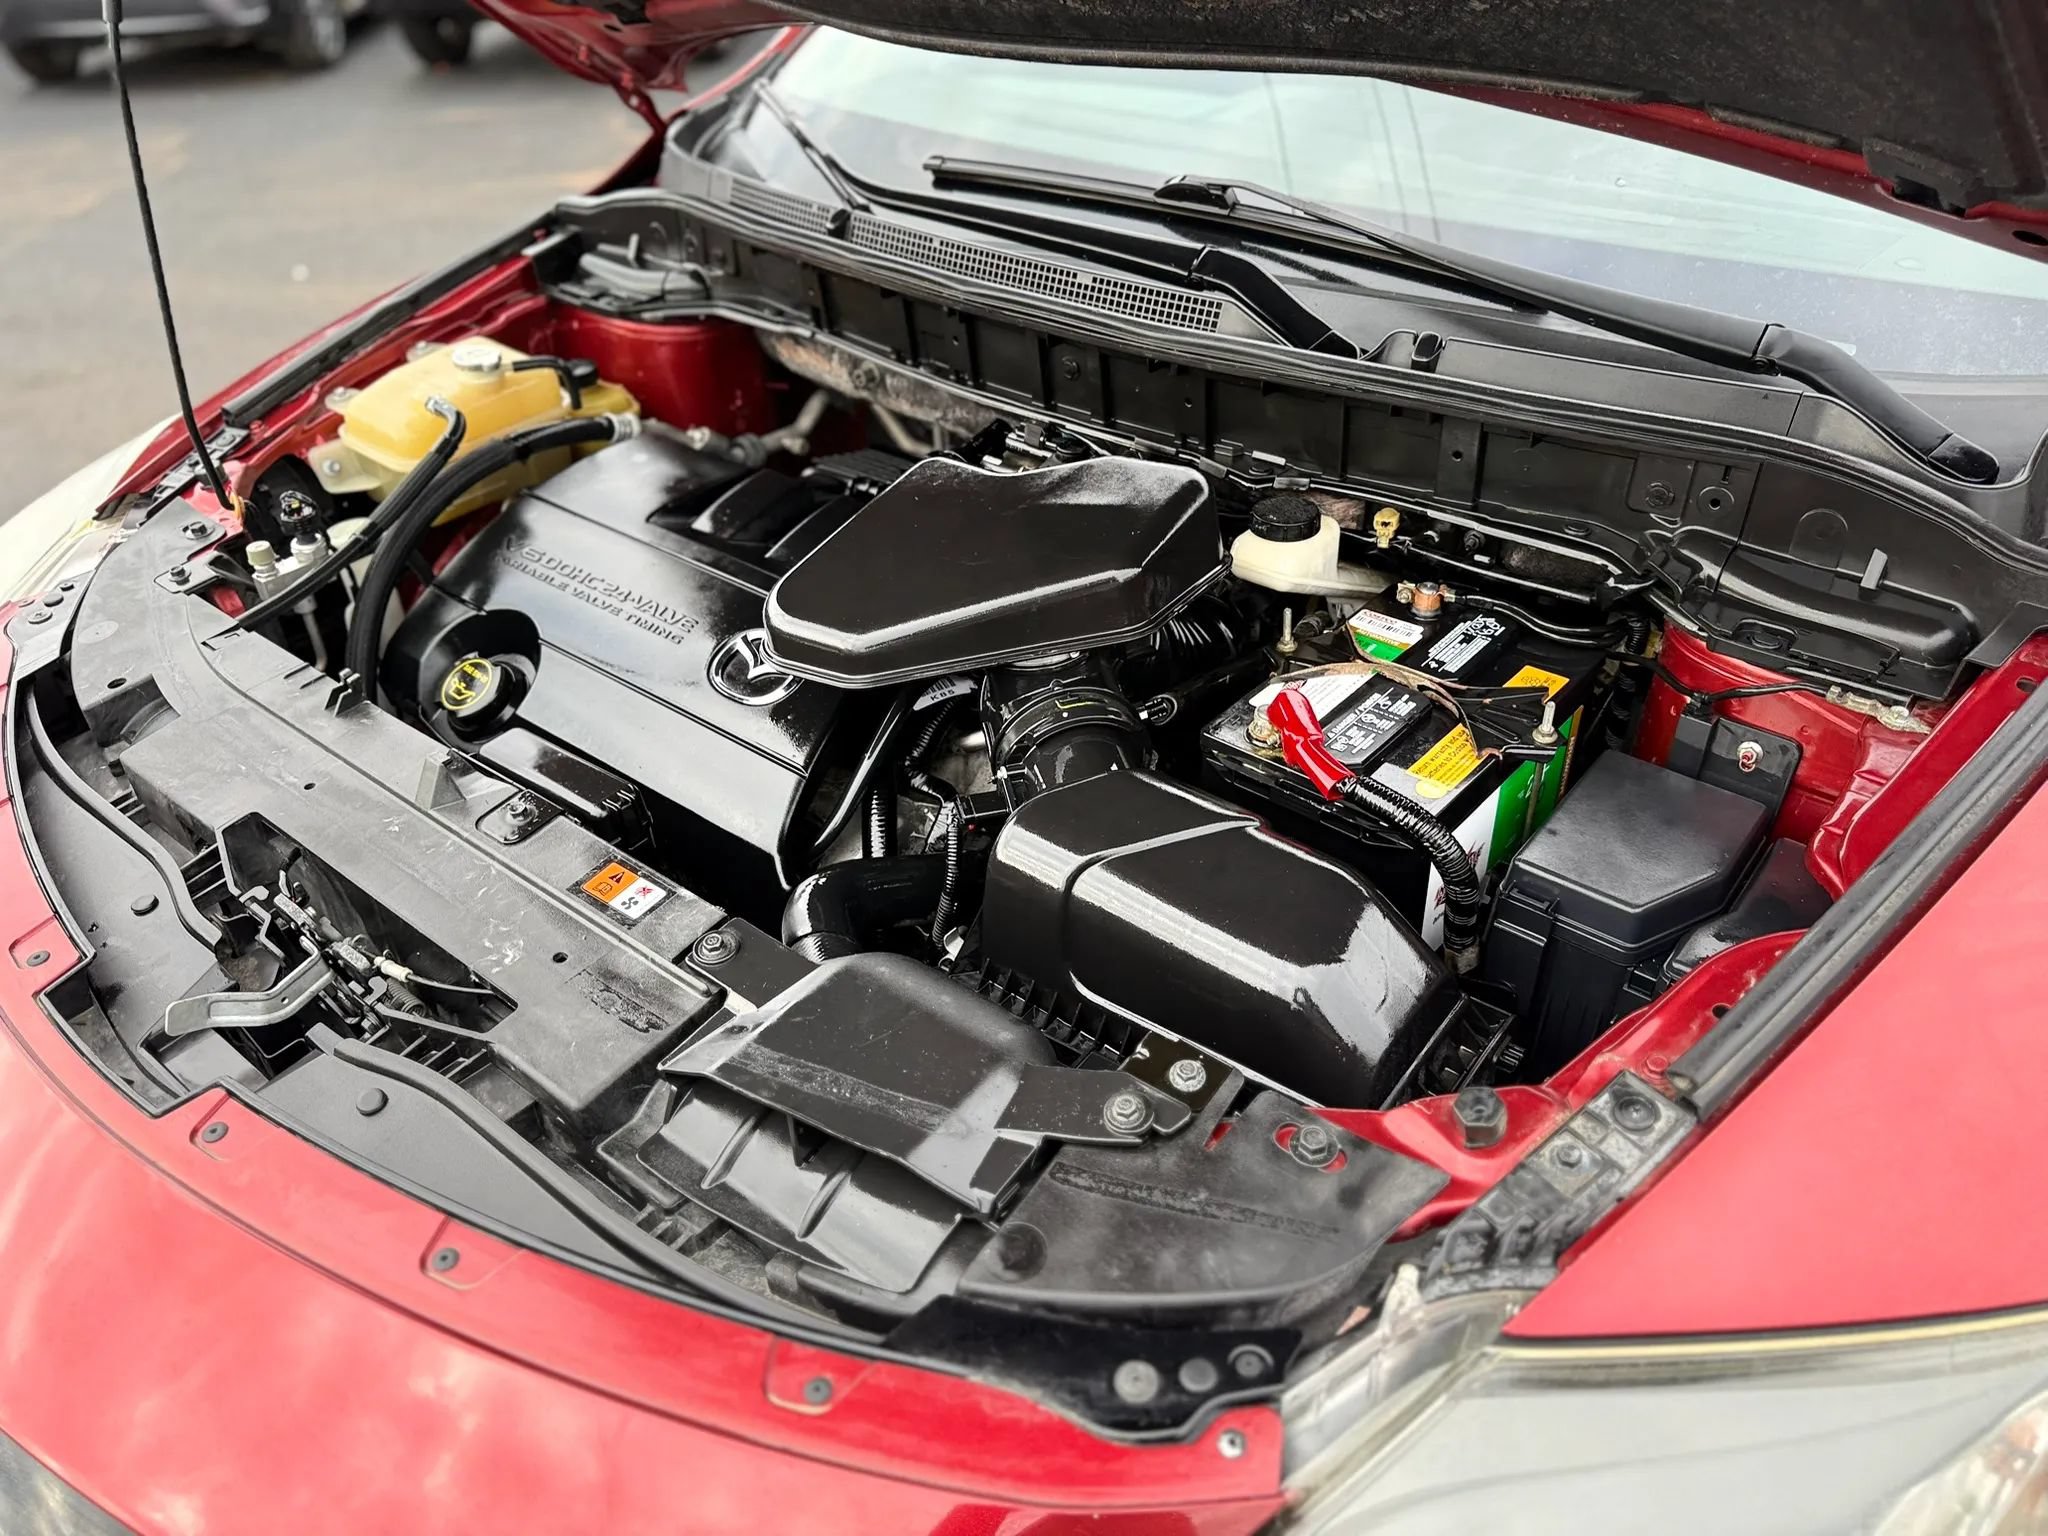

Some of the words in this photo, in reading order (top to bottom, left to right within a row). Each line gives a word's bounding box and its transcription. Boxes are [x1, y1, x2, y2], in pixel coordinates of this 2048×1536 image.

[504, 536, 546, 564] V6
[541, 557, 605, 591] DOHC
[598, 580, 699, 634] 24-VALVE
[571, 587, 623, 617] VALVE
[625, 612, 685, 645] TIMING
